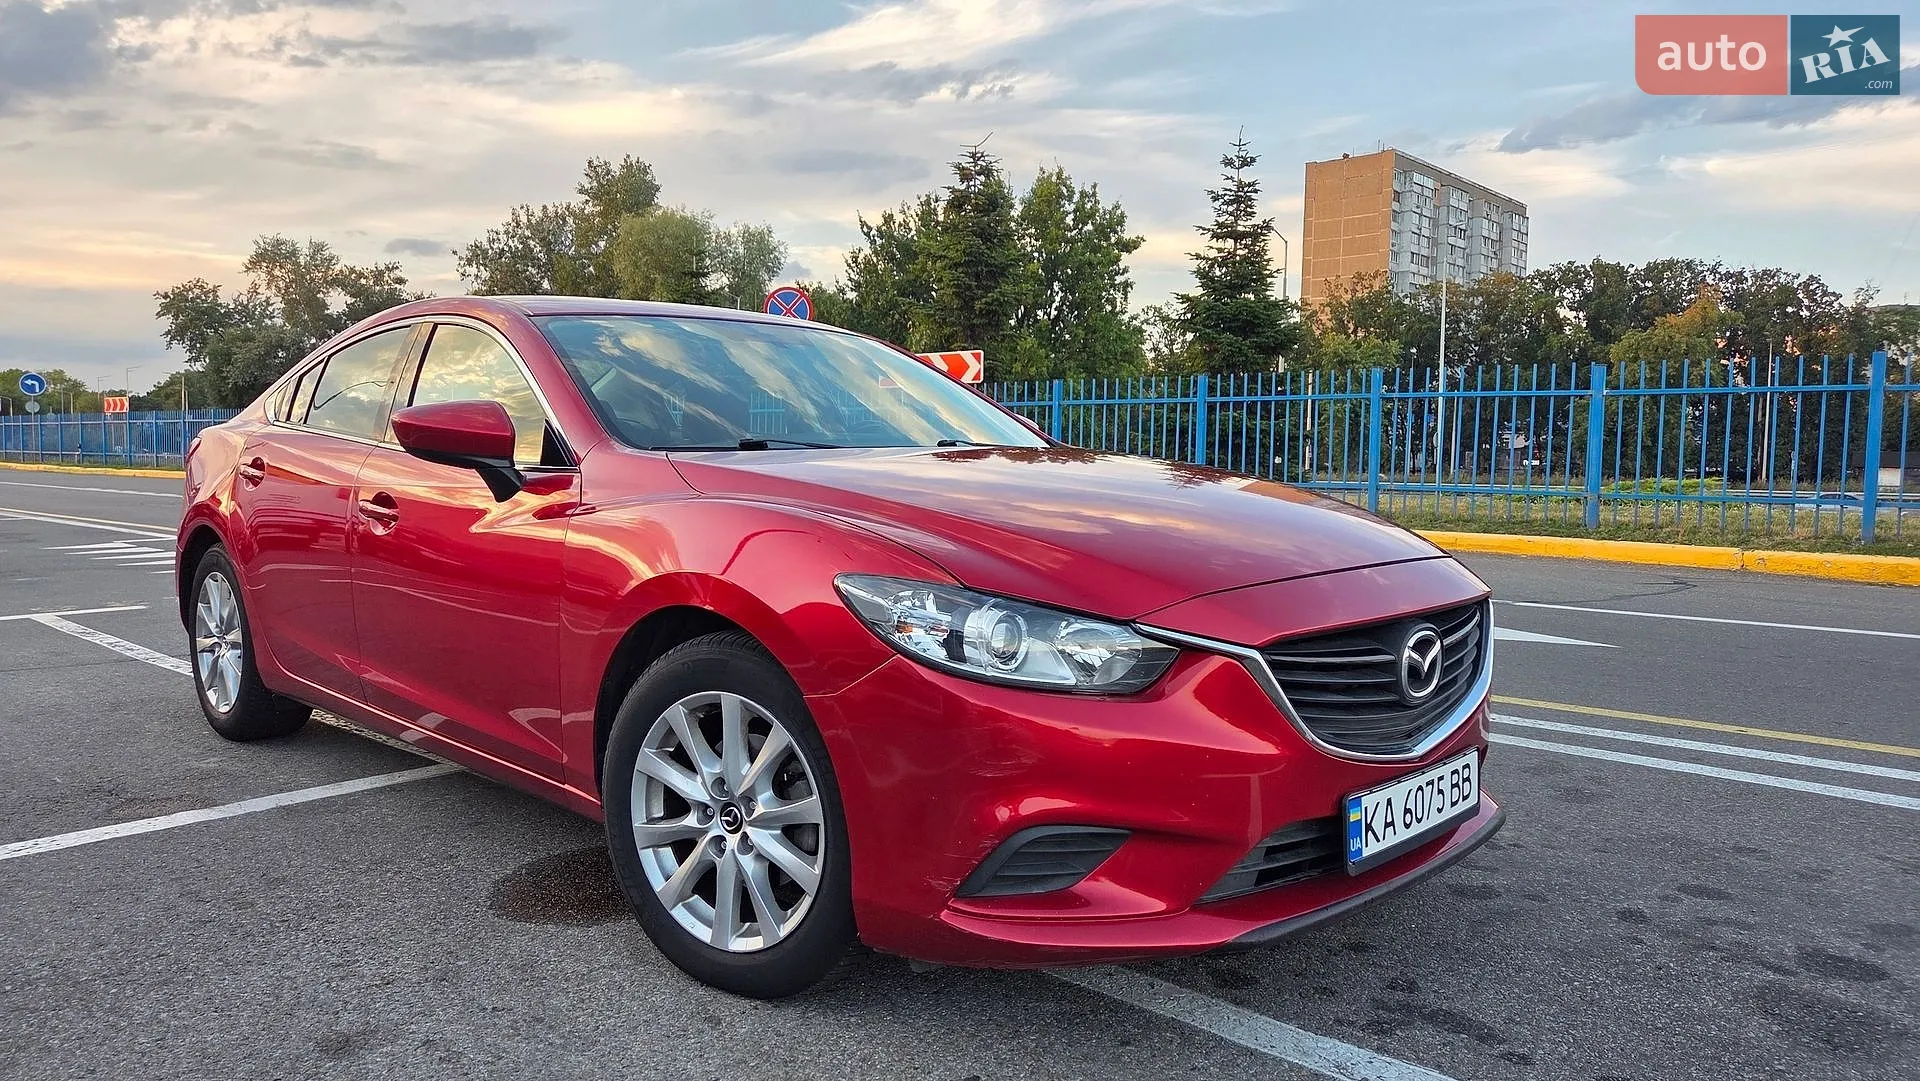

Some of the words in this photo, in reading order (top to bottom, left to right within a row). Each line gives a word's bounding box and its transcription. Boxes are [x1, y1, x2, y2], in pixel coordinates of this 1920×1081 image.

[1364, 797, 1396, 848] KA
[1402, 775, 1445, 830] 6075
[1450, 763, 1472, 808] BB
[1350, 836, 1362, 851] UA
